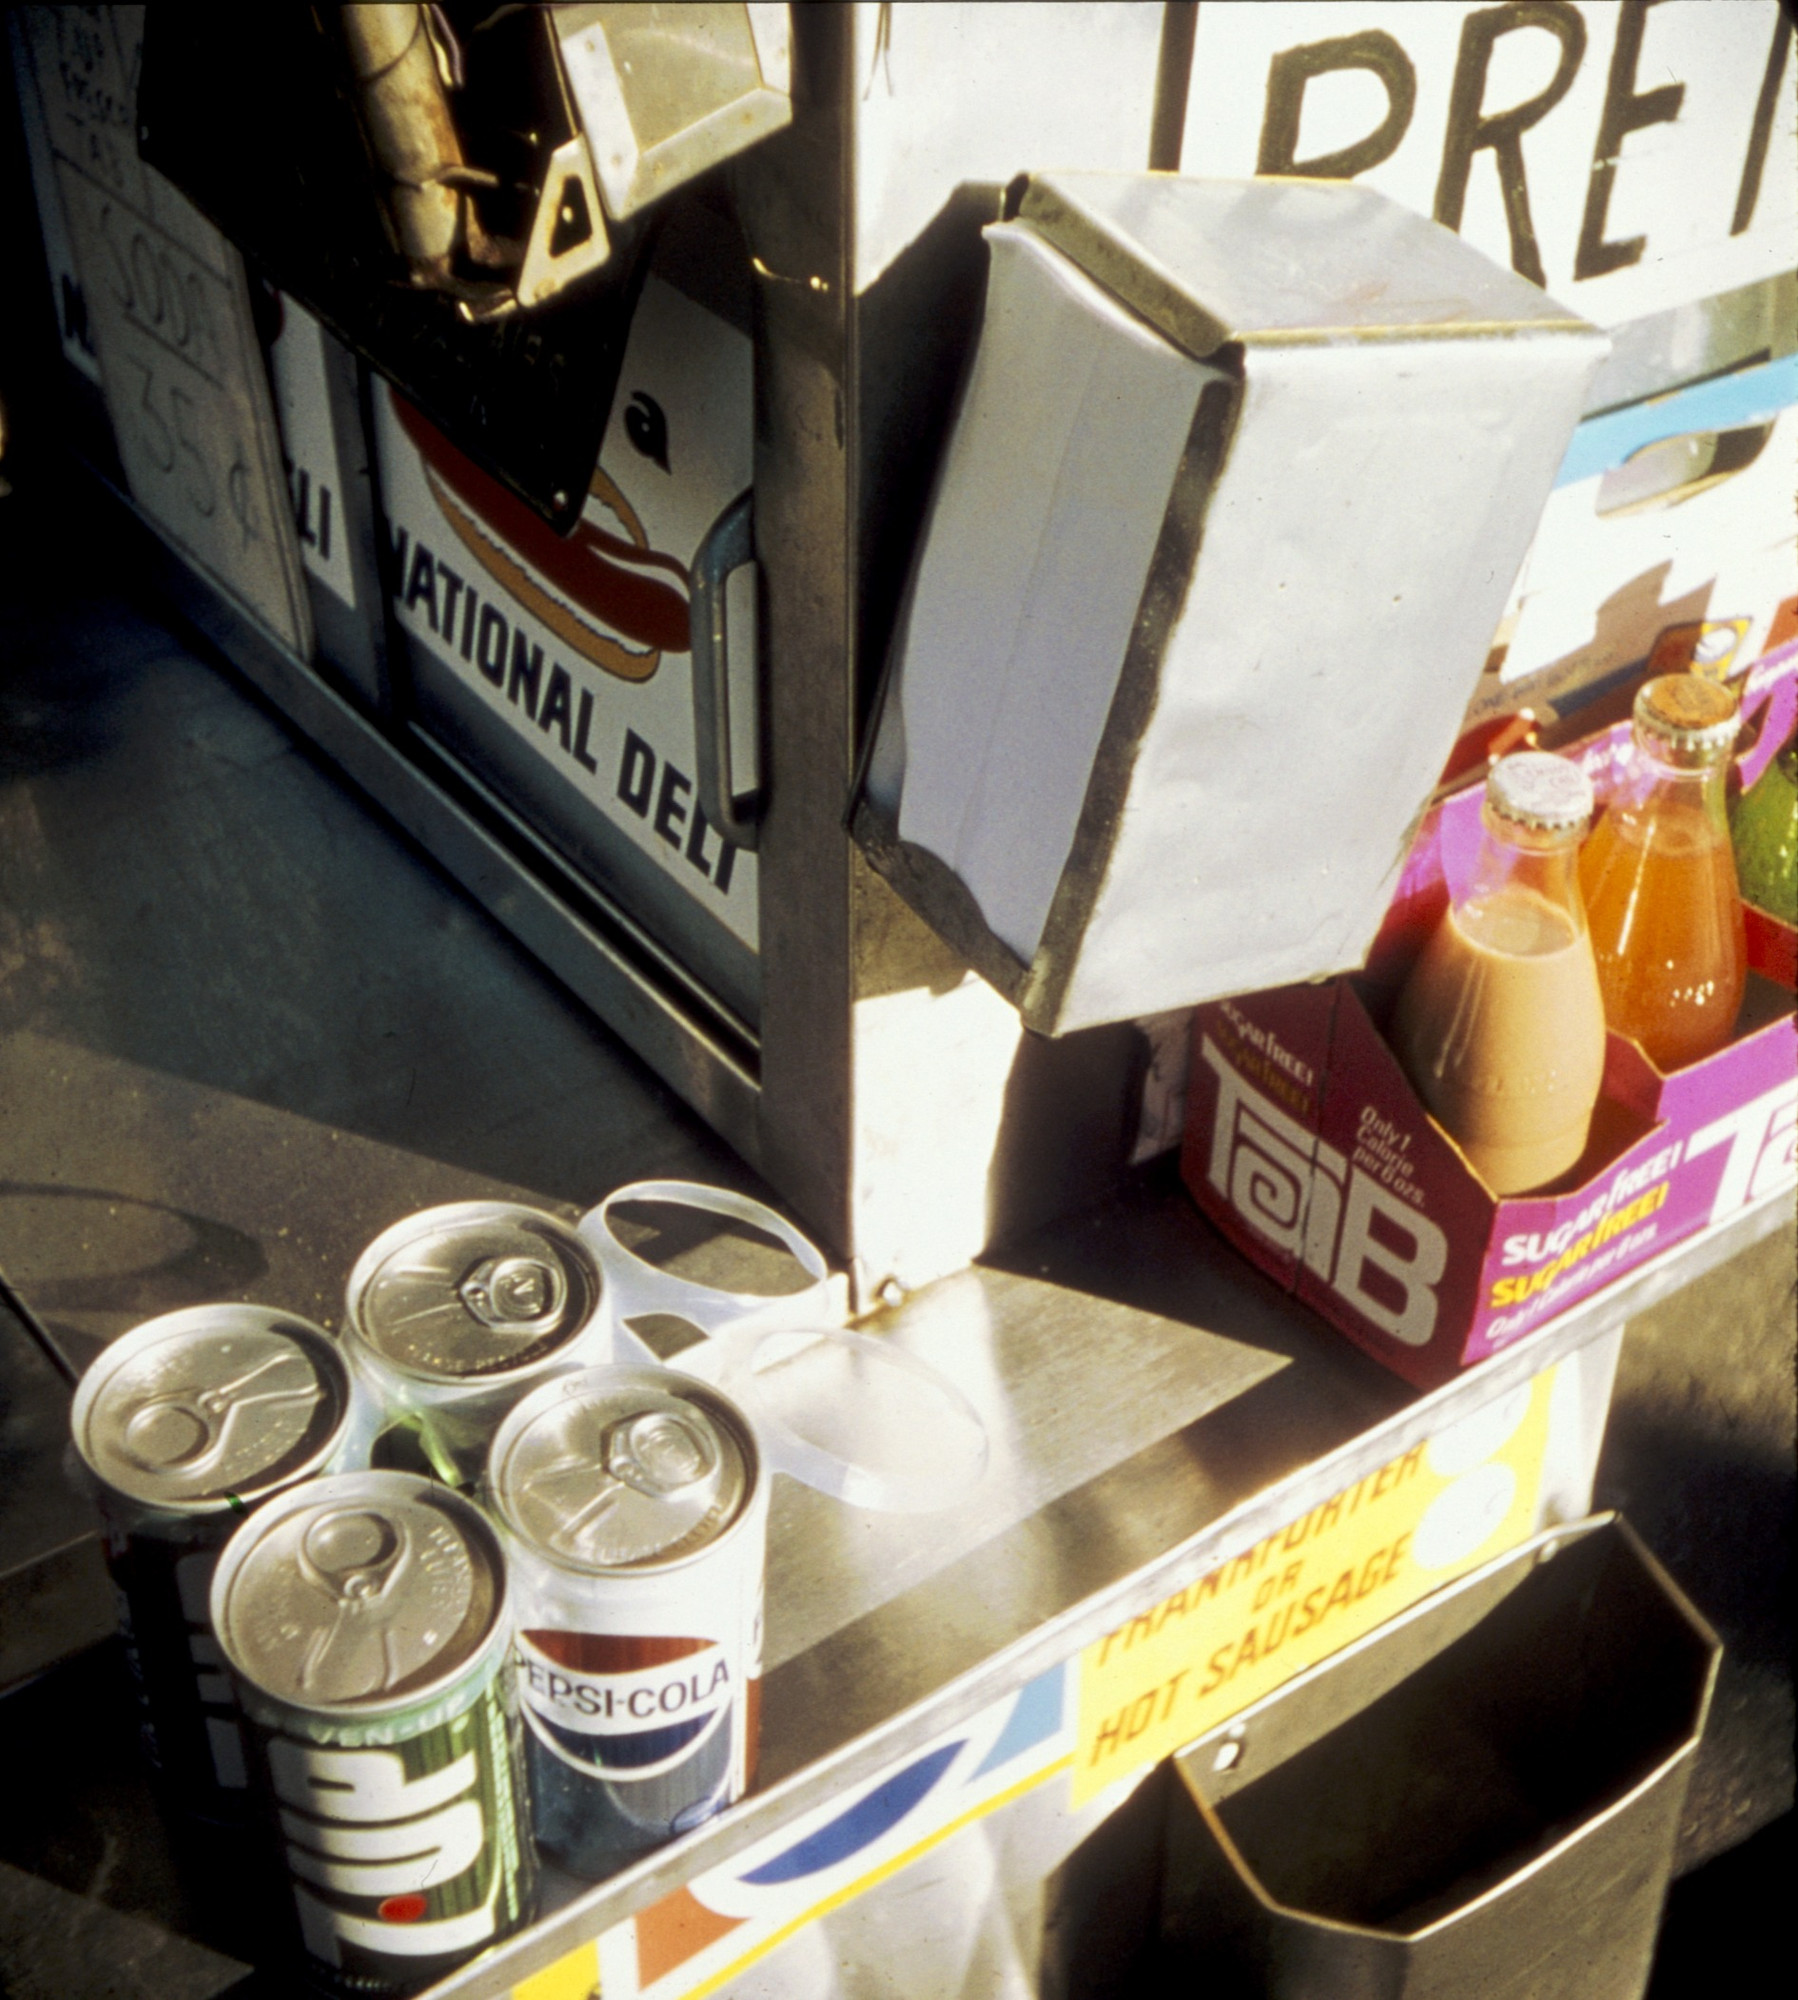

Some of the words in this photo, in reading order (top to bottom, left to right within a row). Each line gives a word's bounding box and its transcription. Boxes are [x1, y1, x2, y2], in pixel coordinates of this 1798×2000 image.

[616, 727, 738, 896] DELI
[1356, 1126, 1416, 1175] Calorie
[1360, 1105, 1400, 1146] Only
[1352, 1146, 1383, 1175] per
[1251, 1559, 1304, 1613] OR
[1089, 1669, 1190, 1768] HOT
[1198, 1531, 1413, 1699] SAUSAGE
